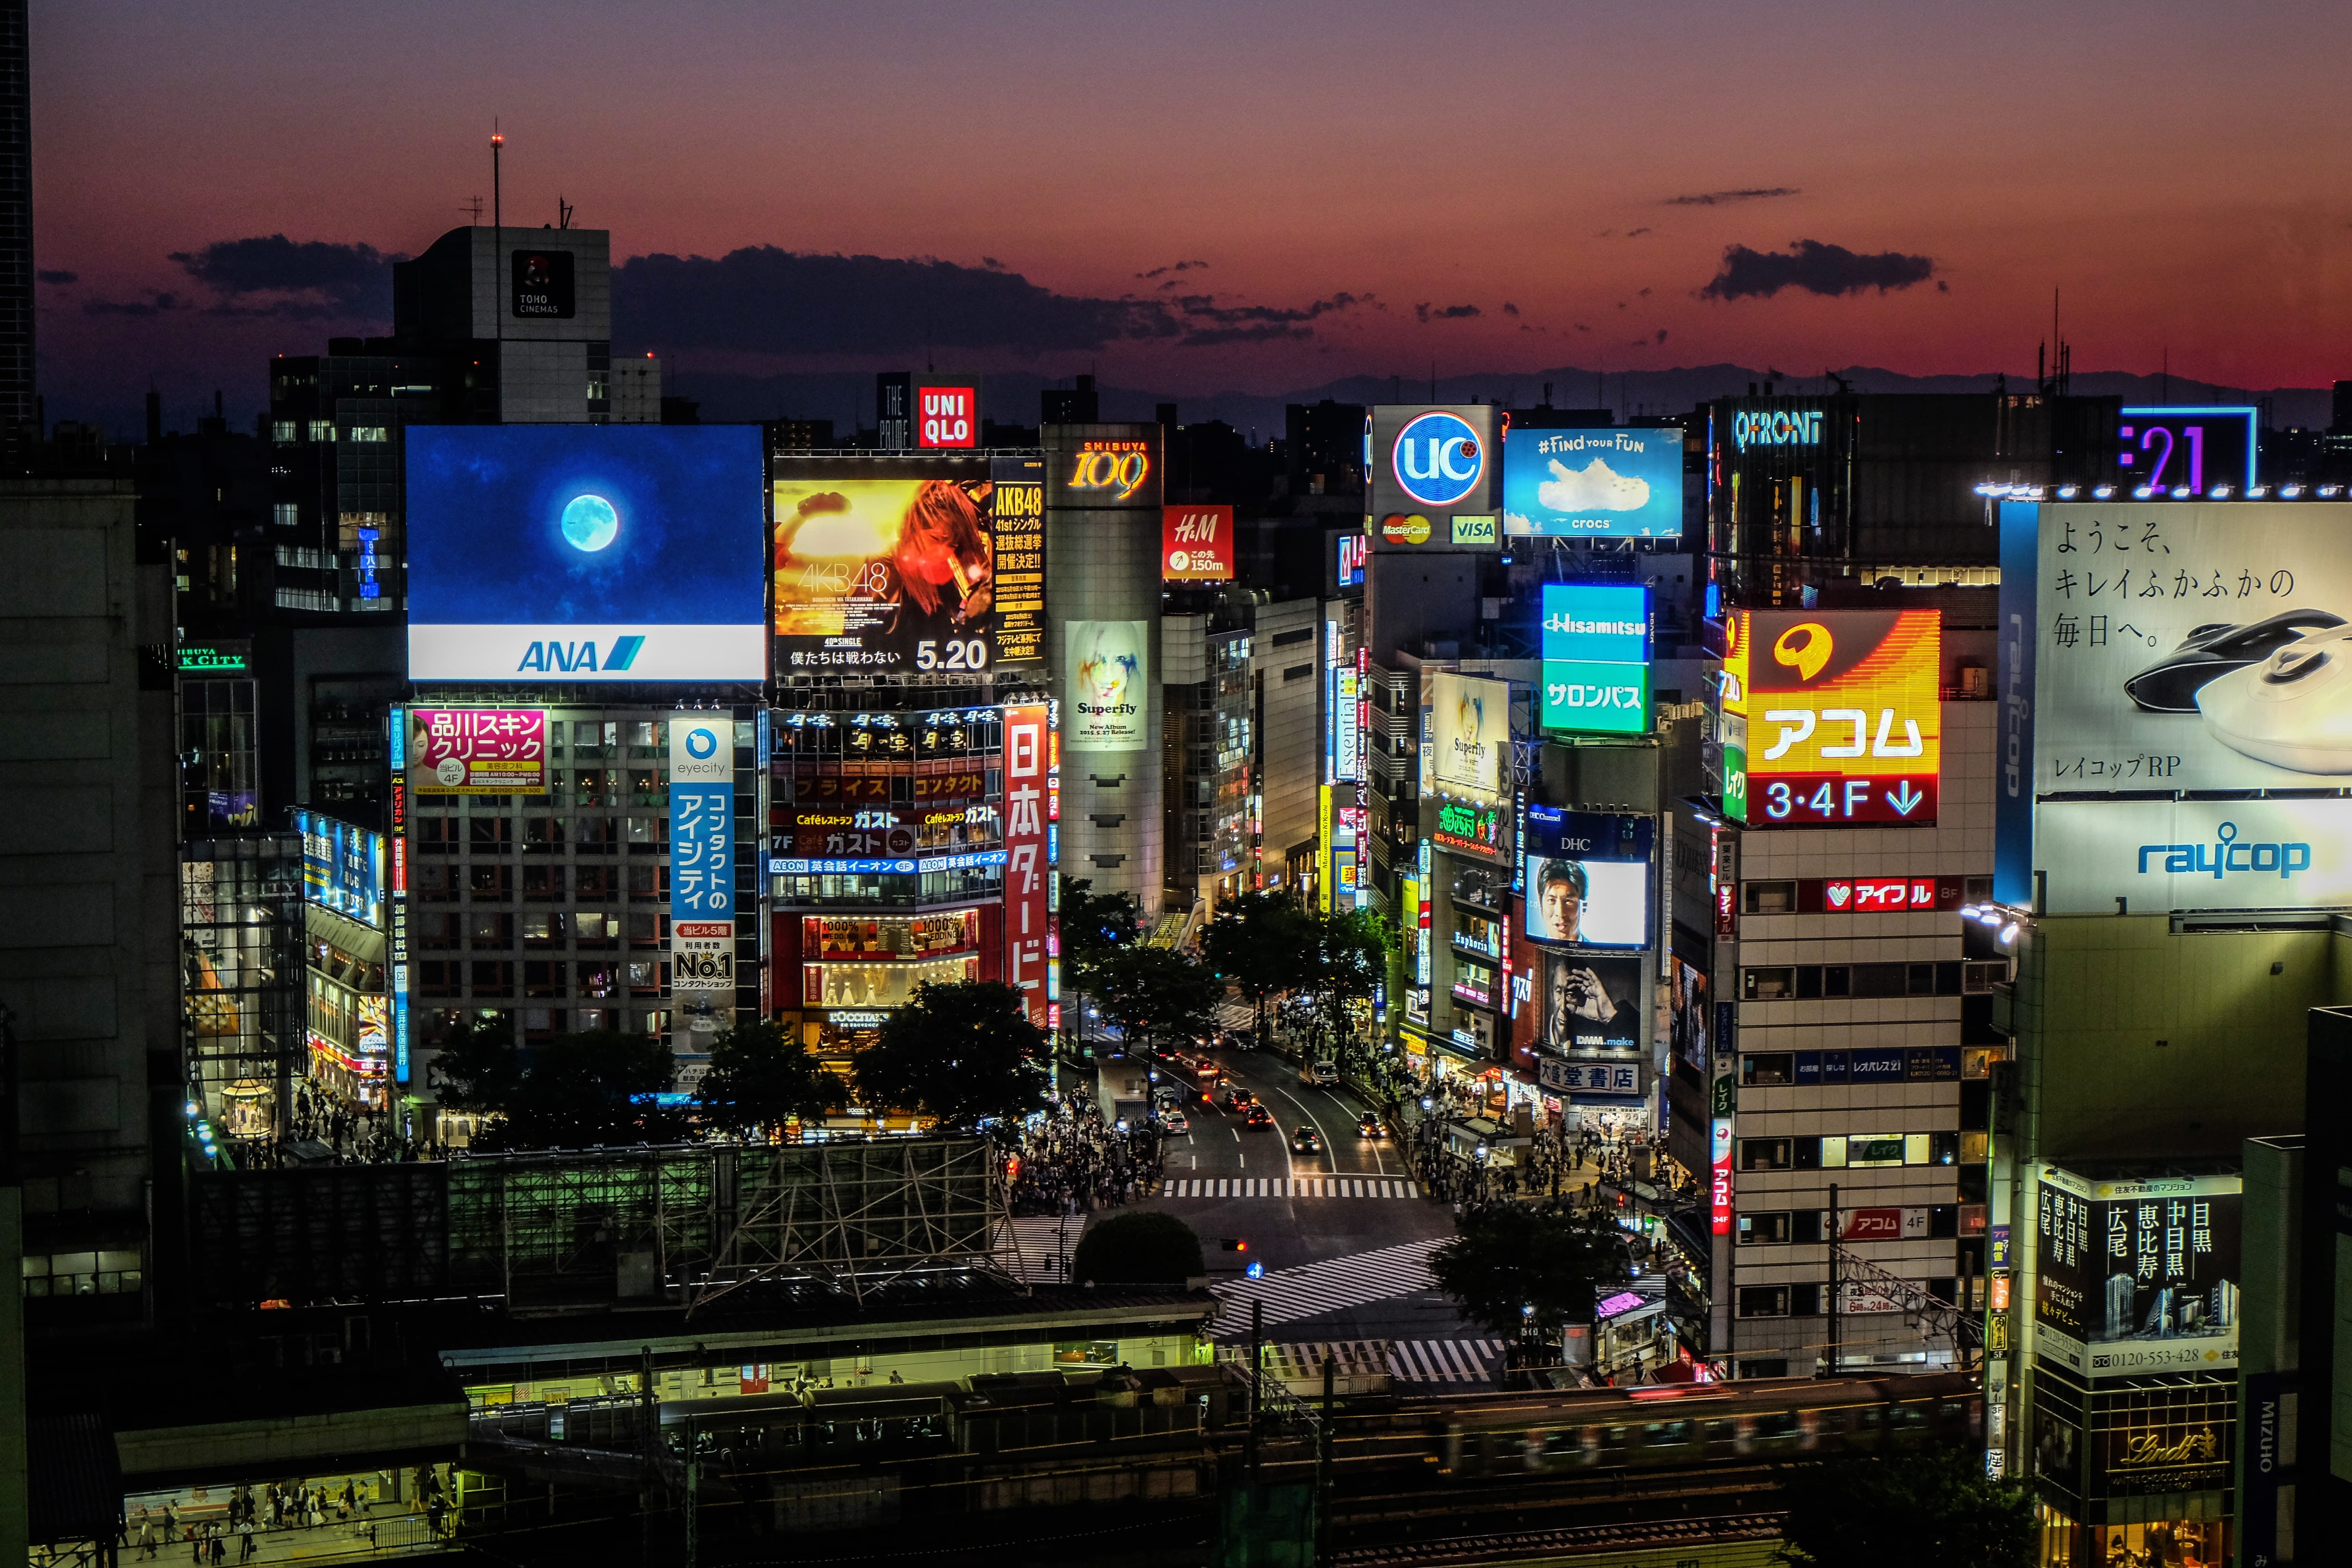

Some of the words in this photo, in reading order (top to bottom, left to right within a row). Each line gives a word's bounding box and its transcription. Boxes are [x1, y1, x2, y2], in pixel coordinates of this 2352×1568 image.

[520, 295, 547, 304] TOHO
[886, 386, 903, 416] THE
[925, 395, 964, 416] UNI
[880, 420, 908, 449] PRIME
[924, 420, 967, 443] QLO
[1736, 411, 1823, 453] QFRONT
[1084, 442, 1146, 452] SHIBUYA
[1586, 439, 1613, 447] YOUR
[1615, 434, 1644, 453] FUN
[1404, 437, 1478, 480] UC
[1068, 452, 1149, 500] 109
[995, 487, 1041, 516] AKB48
[1175, 514, 1219, 543] H&M
[1383, 524, 1430, 536] MasterCard
[1457, 523, 1494, 537] VISA
[1572, 518, 1610, 529] crocs
[995, 534, 1042, 551] 選抜総選挙
[2057, 521, 2170, 555] ようこそ、
[1191, 550, 1215, 559] この先
[1191, 559, 1223, 571] 150m
[797, 563, 887, 592] AKB48
[2055, 568, 2294, 599] キレイふかふかの
[1543, 613, 1646, 637] Hisamitsu
[2054, 612, 2157, 648] 毎日へ。
[198, 655, 243, 665] CITY
[517, 641, 598, 672] ANA
[790, 651, 901, 665] 僕たちは戦わない
[917, 640, 986, 670] 5.20
[1548, 683, 1642, 709] サロンパス
[2005, 613, 2028, 797] raycop
[786, 713, 832, 726] 月の宴
[851, 713, 896, 726] 月の宴
[926, 712, 959, 725] 月の宴
[962, 710, 995, 723] 月の宴
[1077, 702, 1137, 716] Superfly
[431, 713, 541, 737] 品川スキン
[1764, 709, 1924, 760] アコム
[432, 737, 540, 759] クリニック
[851, 733, 910, 751] 月の宴
[922, 730, 965, 749] 月の宴
[1339, 697, 1356, 778] Essential
[1454, 737, 1486, 759] Superfly
[439, 764, 463, 772] 当ビル
[677, 763, 725, 776] eyecity
[443, 775, 459, 783] 4F
[796, 779, 887, 796] プライス
[916, 774, 985, 794] コンタクト
[393, 786, 403, 823] アメリカン
[965, 806, 997, 824] ガスト
[855, 811, 899, 829] ガスト
[1539, 813, 1561, 822] Channel
[772, 836, 793, 849] 7F
[798, 835, 823, 845] Café
[826, 833, 881, 854] ガスト
[1561, 837, 1591, 851] DHC
[2138, 821, 2310, 879] raycop
[678, 795, 703, 909] アイシティ
[709, 795, 727, 909] コンタクトの
[948, 853, 1006, 868] 英会話イーオン
[773, 862, 804, 871] AEON
[811, 860, 892, 872] 英会話イーオン
[921, 860, 943, 870] AEON
[1856, 883, 1932, 904] アイフル
[1941, 887, 1958, 899] 8F
[1720, 895, 1732, 933] アイフル
[394, 904, 405, 951] 加藤眼科
[683, 926, 727, 936] 当ビル5階
[823, 921, 859, 931] 1000%
[923, 917, 960, 933] 1000%
[1455, 931, 1487, 952] Euphoria
[674, 952, 733, 979] No.1
[1576, 1036, 1634, 1046] DMM.make
[1542, 1061, 1634, 1089] 大盛堂書店
[1853, 1060, 1901, 1072] レオパレス21
[1718, 1084, 1727, 1111] レイク
[1871, 1142, 1899, 1155] レイク
[1714, 1168, 1728, 1206] アコム
[2115, 1182, 2192, 1194] 住友不動産のマンション
[1857, 1216, 1898, 1231] アコム
[1906, 1217, 1925, 1229] 4F
[2041, 1190, 2050, 1236] 広尾
[2053, 1194, 2064, 1262] 恵比寿
[2066, 1193, 2075, 1267] 中目黒
[2078, 1204, 2088, 1252] 目黒
[2108, 1207, 2129, 1257] 広尾
[2193, 1202, 2212, 1253] 目黒
[2138, 1204, 2159, 1280] 恵比寿
[2167, 1201, 2186, 1276] 中目黒
[2042, 1274, 2083, 1302] 憧れのマンションを
[2049, 1290, 2075, 1310] 手に入れる
[2112, 1348, 2199, 1367] 0120-553-428
[1993, 1393, 2002, 1402] 4F
[2260, 1401, 2275, 1472] MIZUHO
[2120, 1433, 2199, 1465] Lindt
